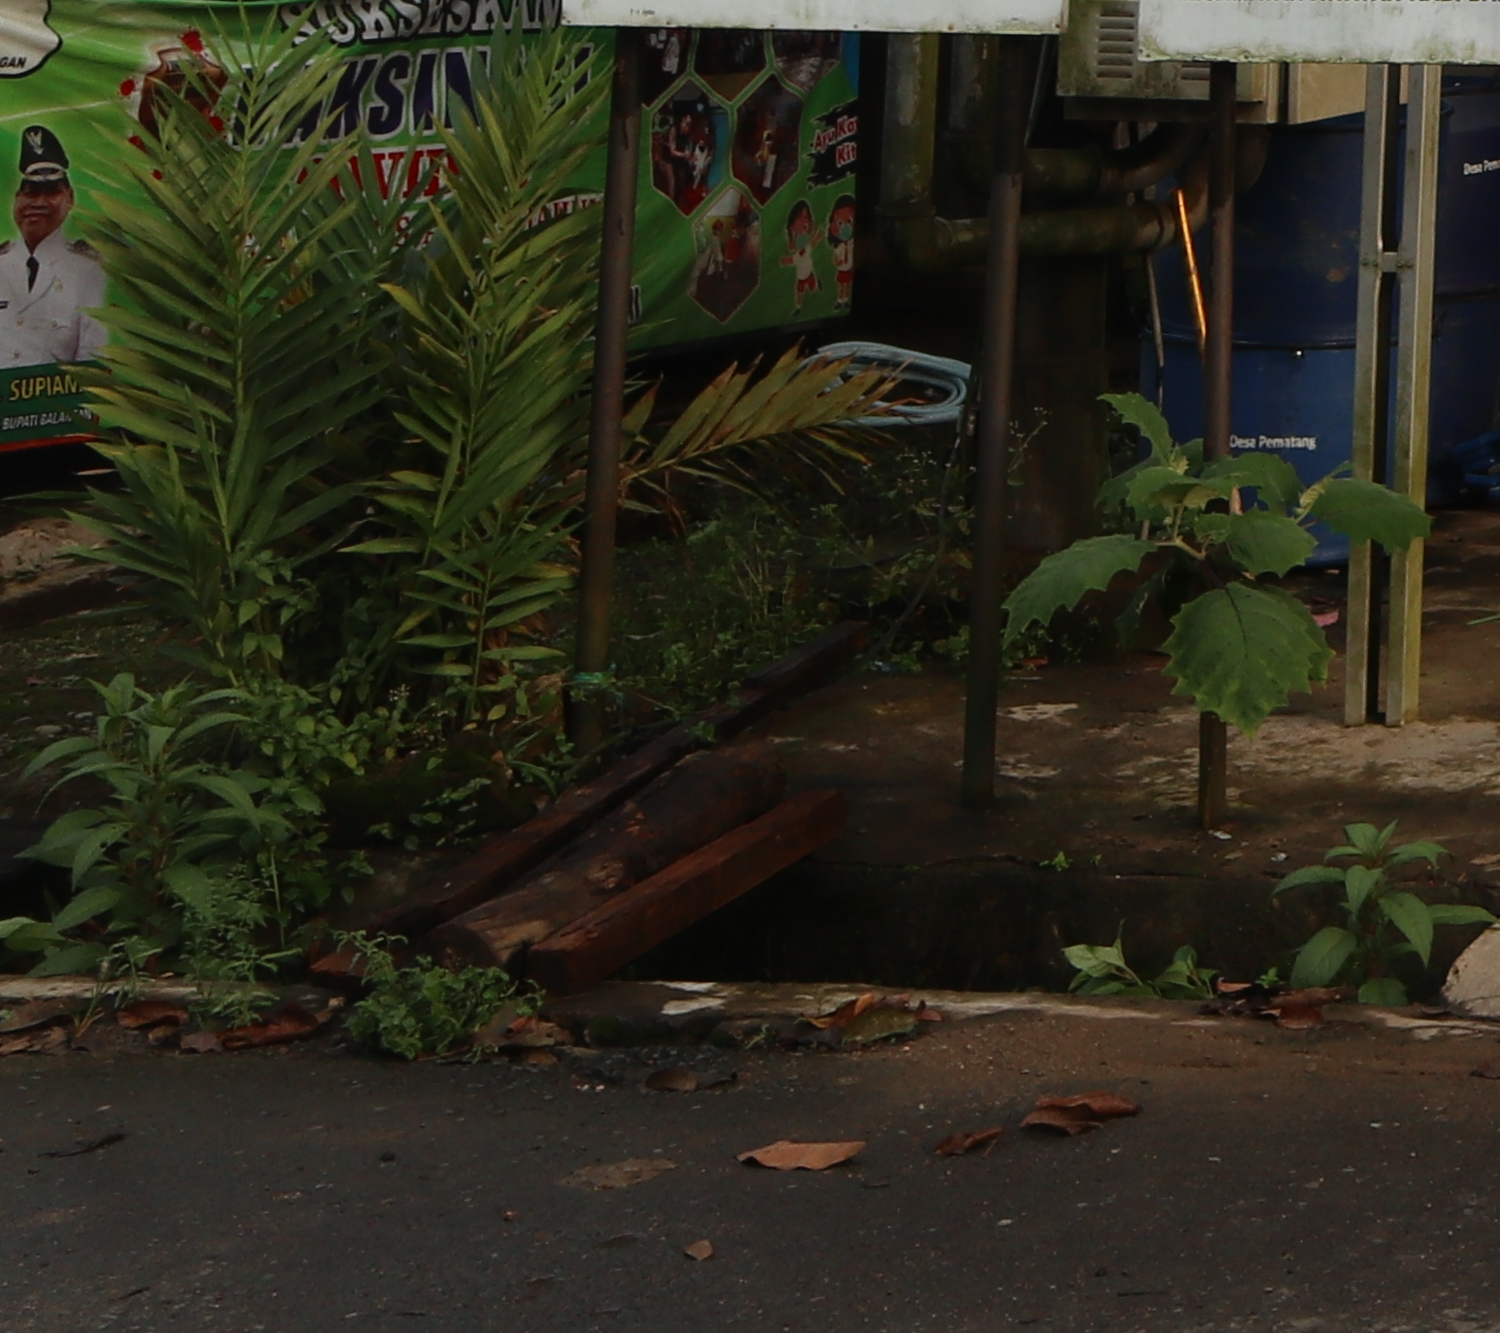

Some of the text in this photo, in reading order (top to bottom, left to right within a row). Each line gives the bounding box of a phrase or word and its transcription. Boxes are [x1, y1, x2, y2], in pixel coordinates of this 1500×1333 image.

[9, 374, 79, 401] SUPIAN
[1230, 435, 1316, 451] Desa Pematang
